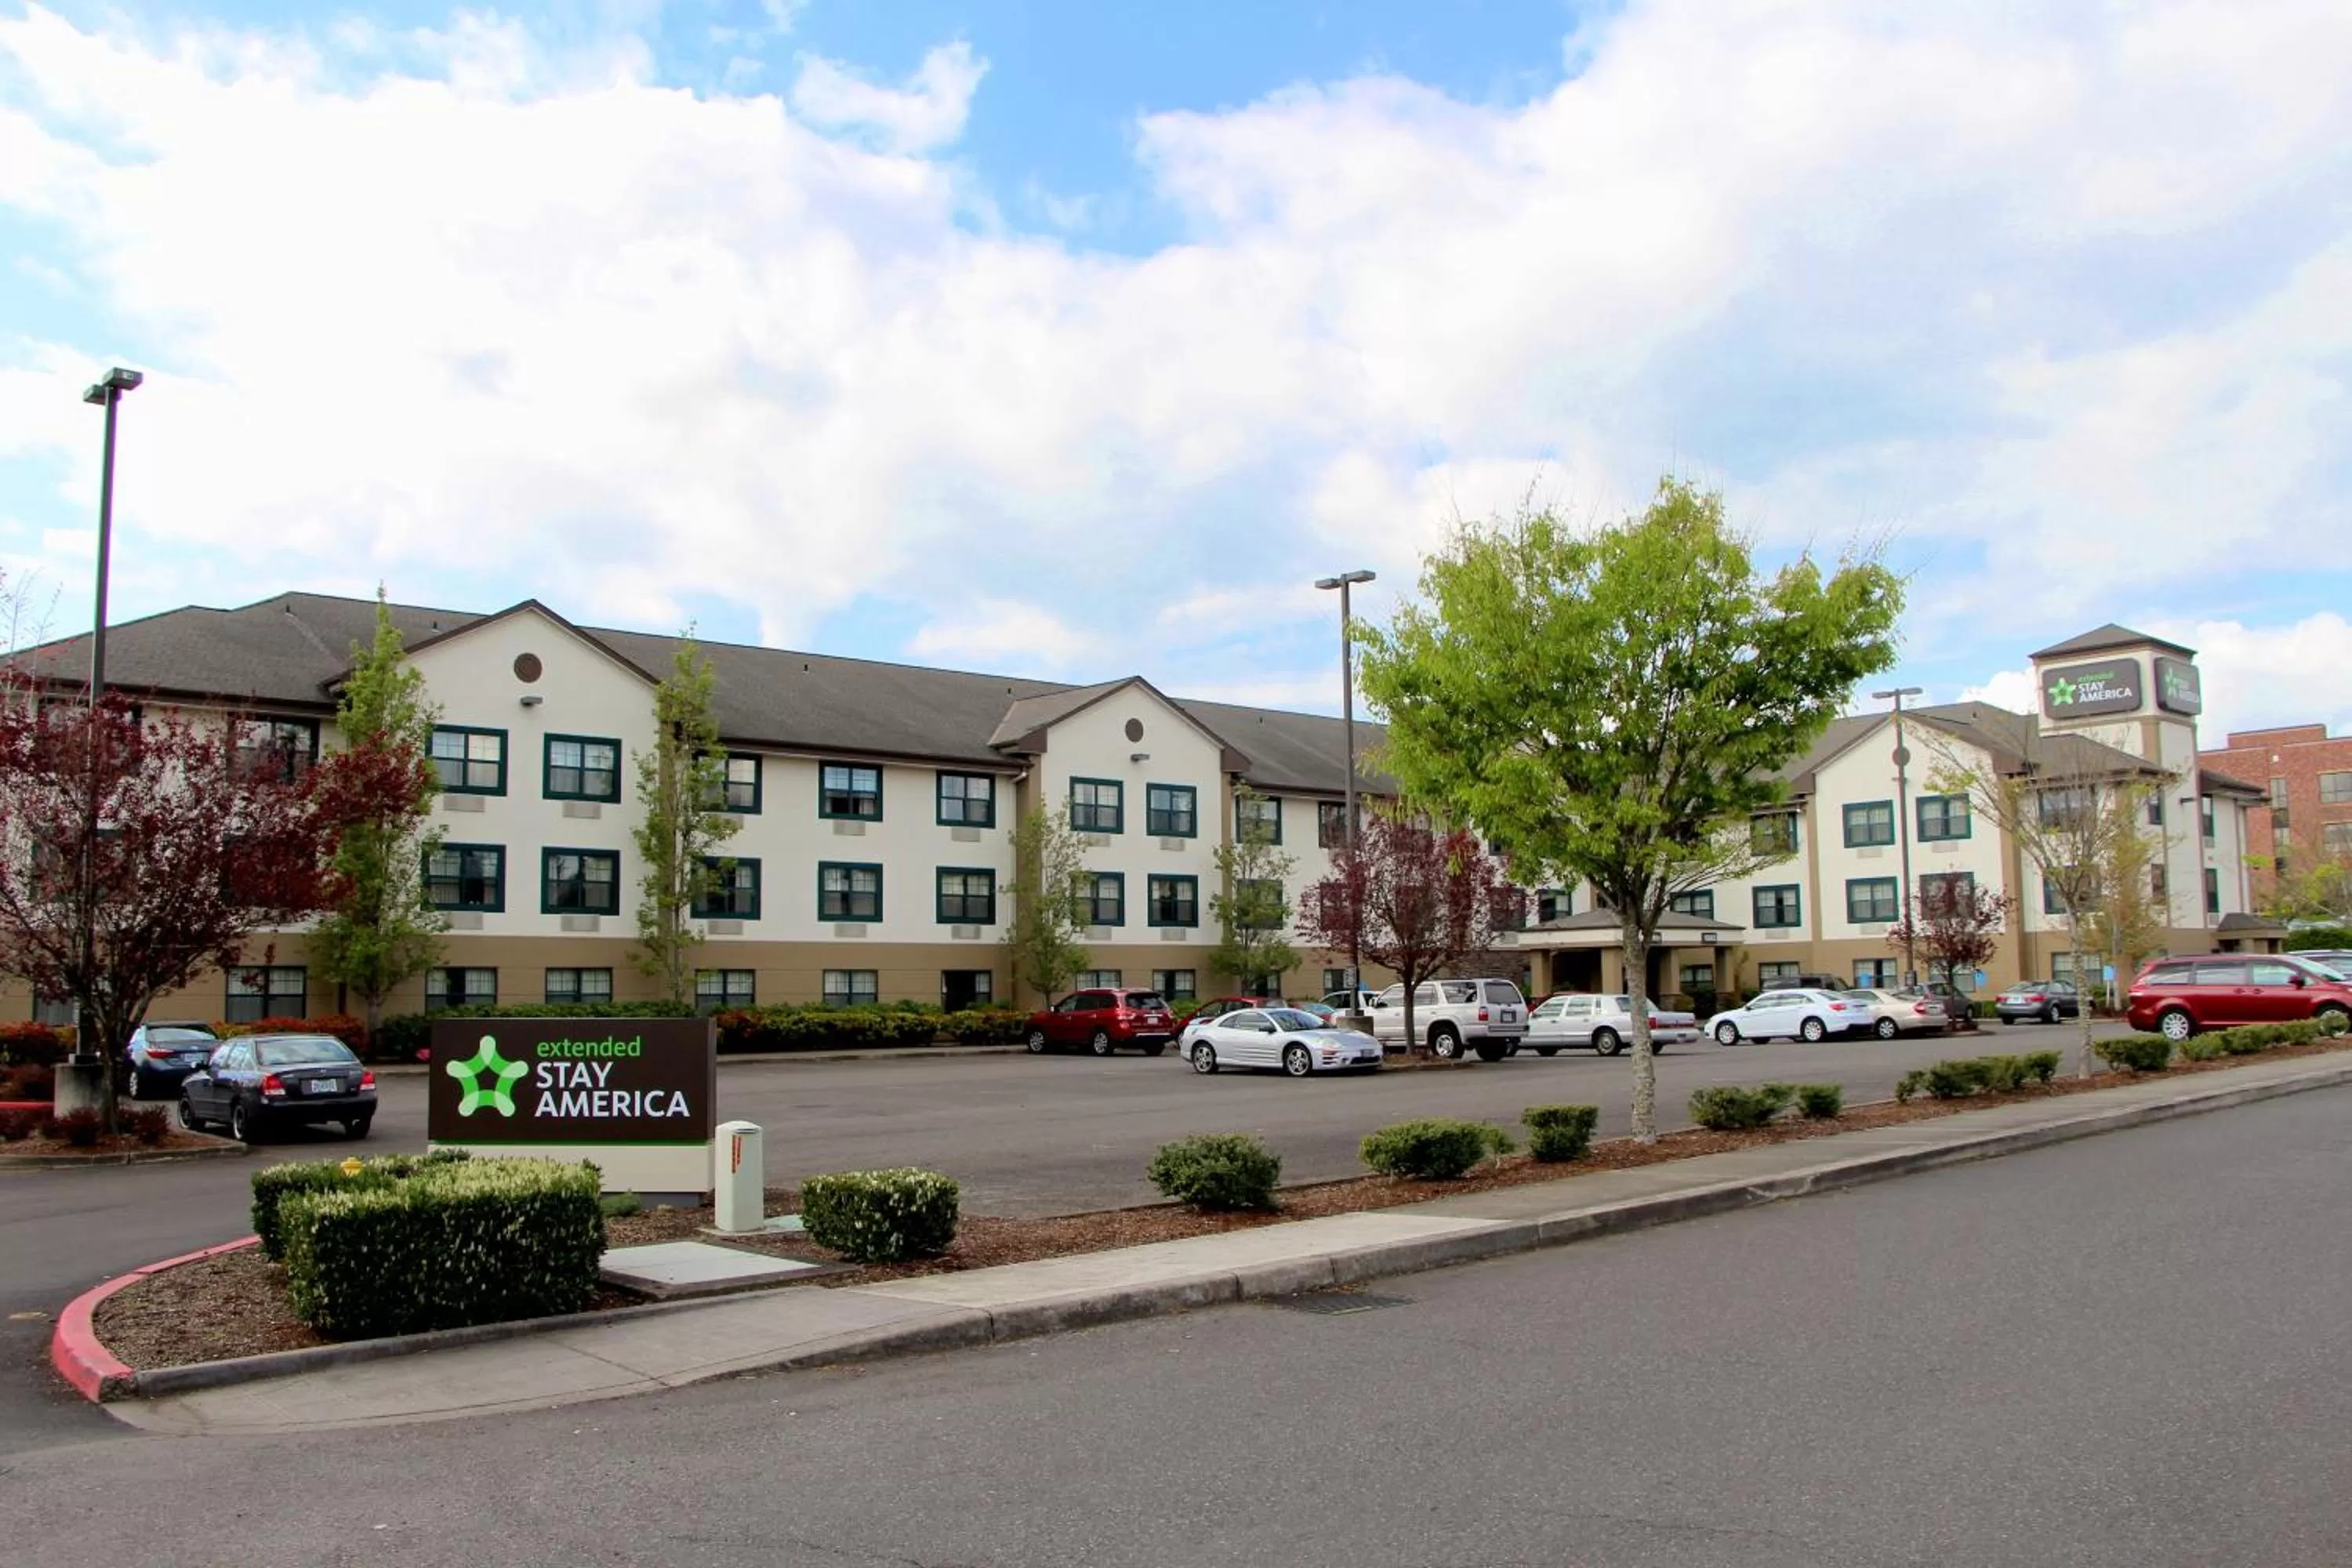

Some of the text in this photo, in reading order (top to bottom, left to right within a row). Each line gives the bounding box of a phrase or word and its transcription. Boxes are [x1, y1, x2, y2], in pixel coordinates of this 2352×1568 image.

[2078, 681, 2105, 692] STAY
[2079, 687, 2132, 703] AMERICA
[536, 1036, 641, 1057] extended
[536, 1062, 613, 1088] STAY
[535, 1091, 690, 1117] AMERICA
